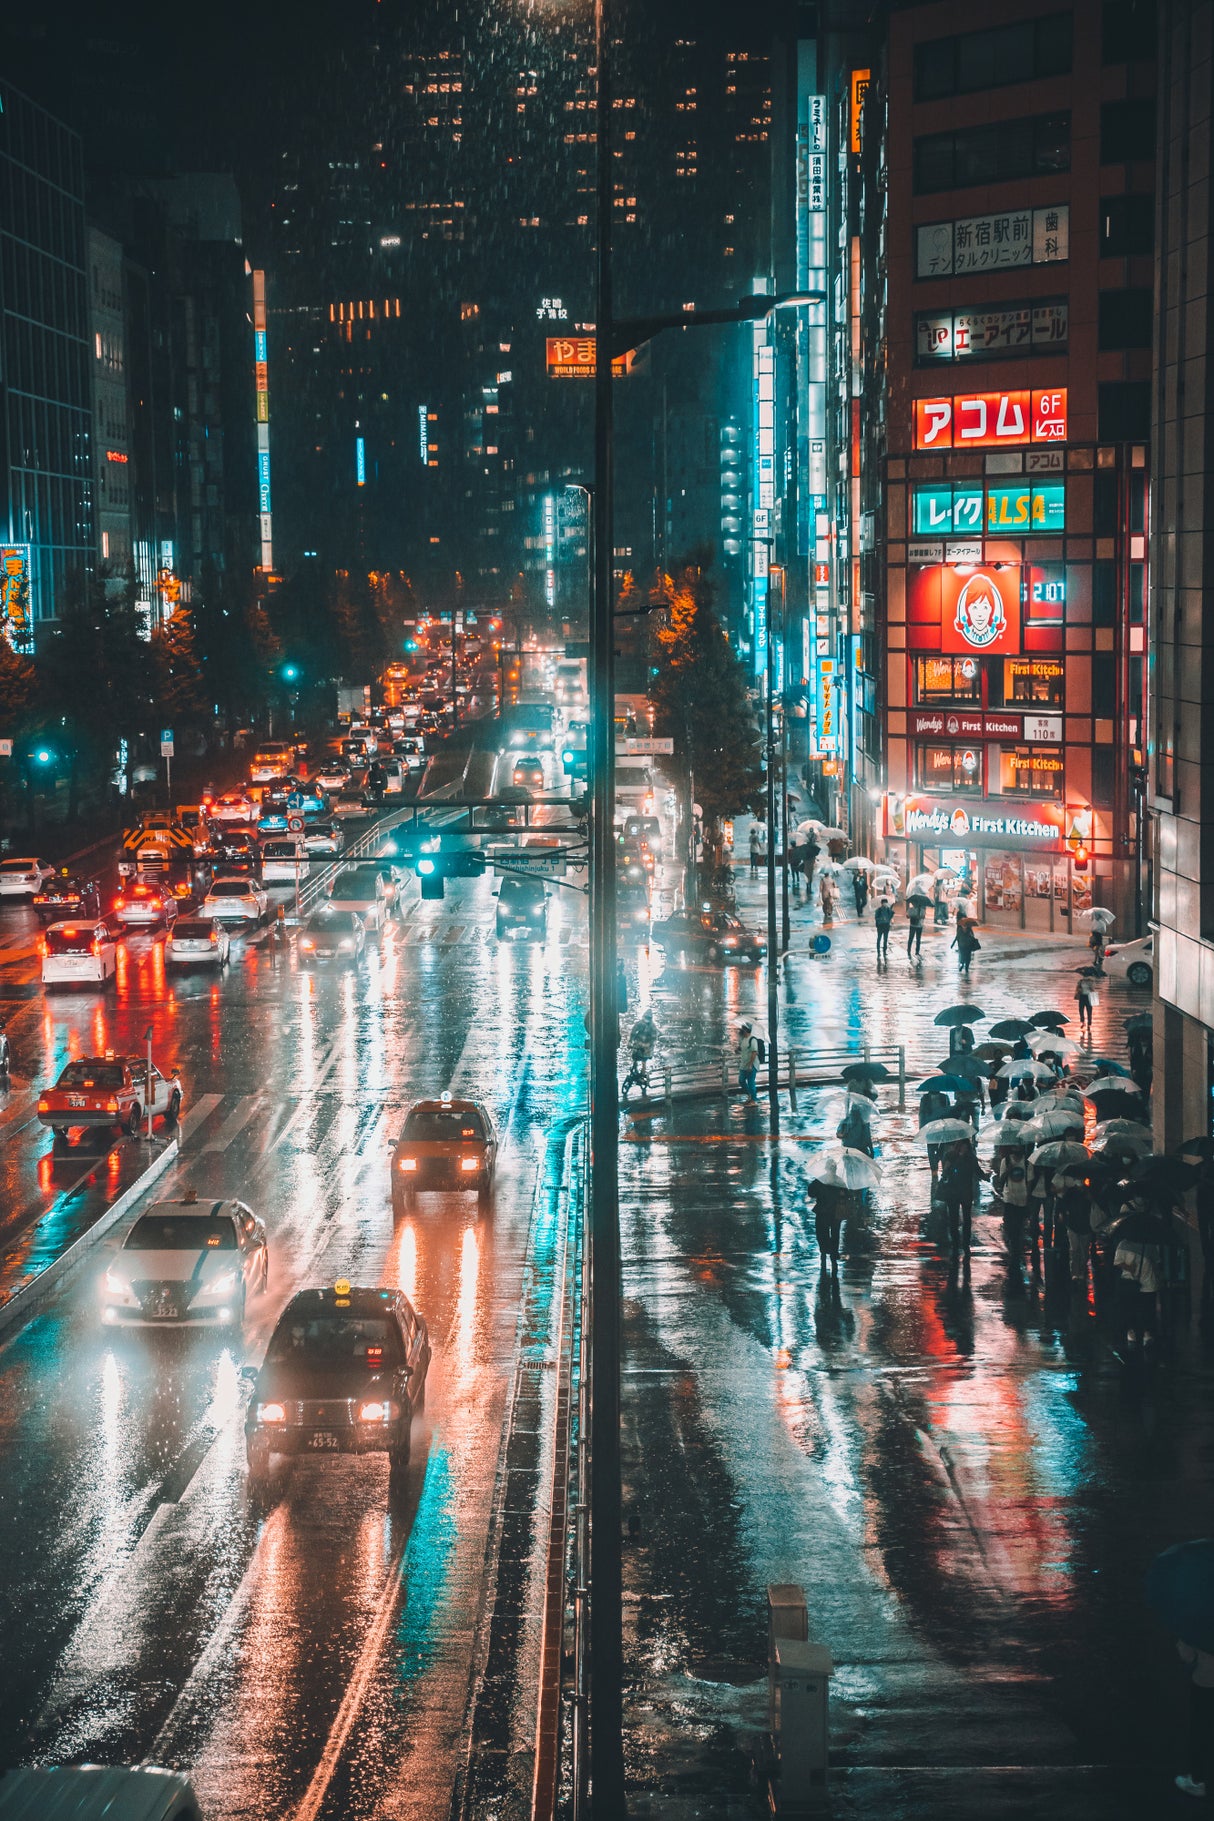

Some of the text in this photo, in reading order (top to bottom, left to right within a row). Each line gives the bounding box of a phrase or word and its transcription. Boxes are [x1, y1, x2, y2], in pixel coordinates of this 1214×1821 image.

[956, 215, 1030, 250] 新宿駅前
[1045, 211, 1059, 258] 歯科
[928, 243, 1033, 274] デンタルクリニック
[955, 318, 1067, 350] エーアイアール
[553, 340, 597, 362] やま
[1040, 394, 1062, 415] 6F
[924, 396, 1025, 444] アコム
[1049, 424, 1065, 437] 入口
[1030, 453, 1061, 470] アコム
[755, 514, 767, 523] 6F
[946, 547, 981, 556] エーアイアール
[1032, 663, 1063, 676] Kitch
[916, 716, 1018, 735] Wendy's First Kitchen
[164, 731, 171, 741] P
[1032, 758, 1063, 771] Kitch
[907, 807, 1060, 839] Wendy's First Kitchen
